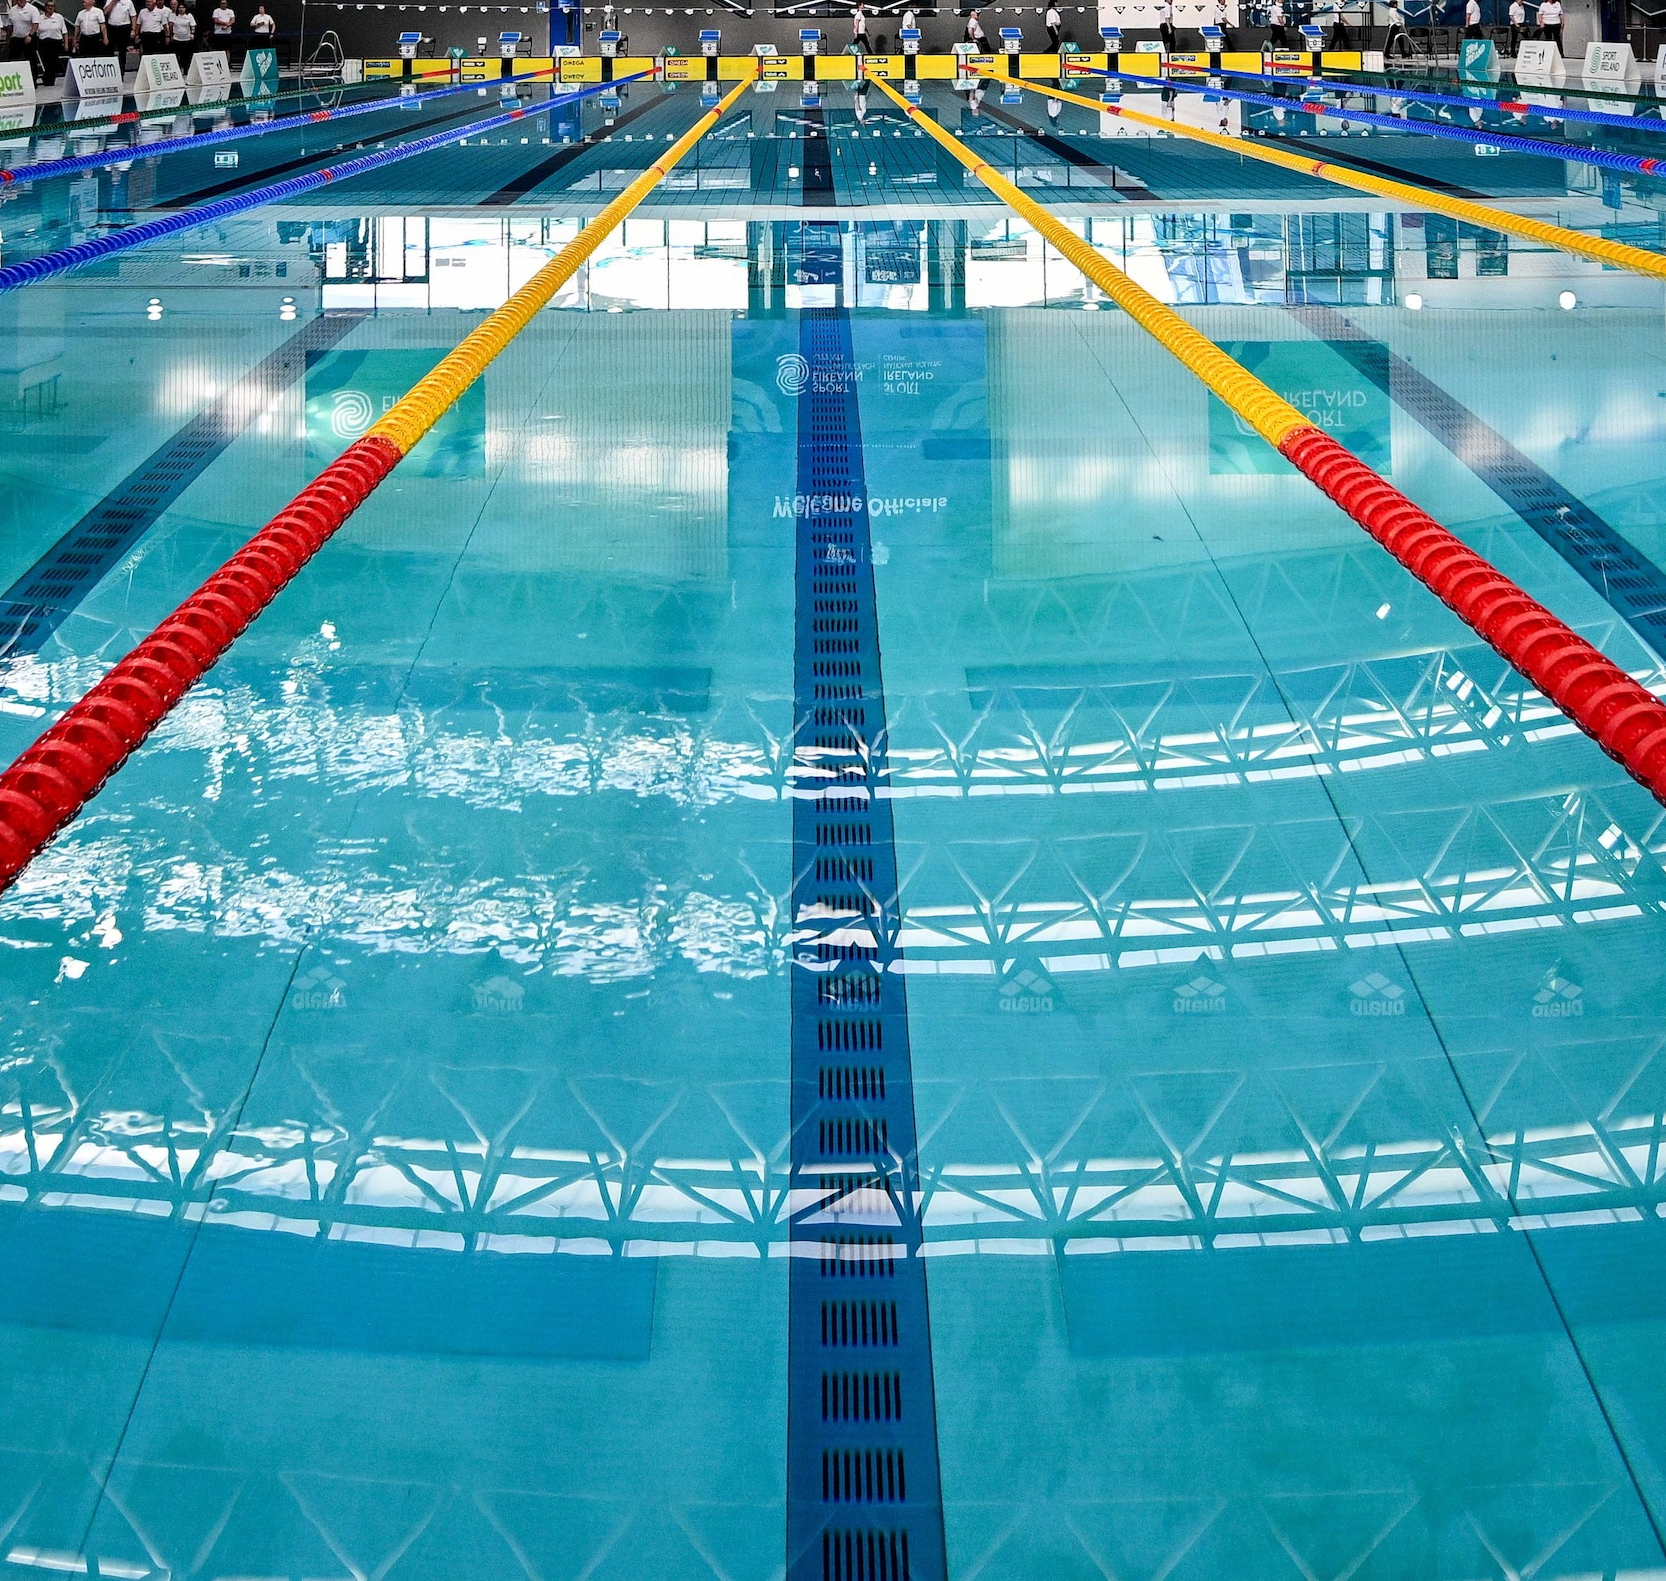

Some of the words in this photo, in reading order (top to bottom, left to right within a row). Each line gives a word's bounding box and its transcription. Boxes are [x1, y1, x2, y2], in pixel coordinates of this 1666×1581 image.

[1601, 50, 1616, 62] SPORT
[79, 59, 118, 83] perform
[1600, 60, 1620, 73] IRELAND
